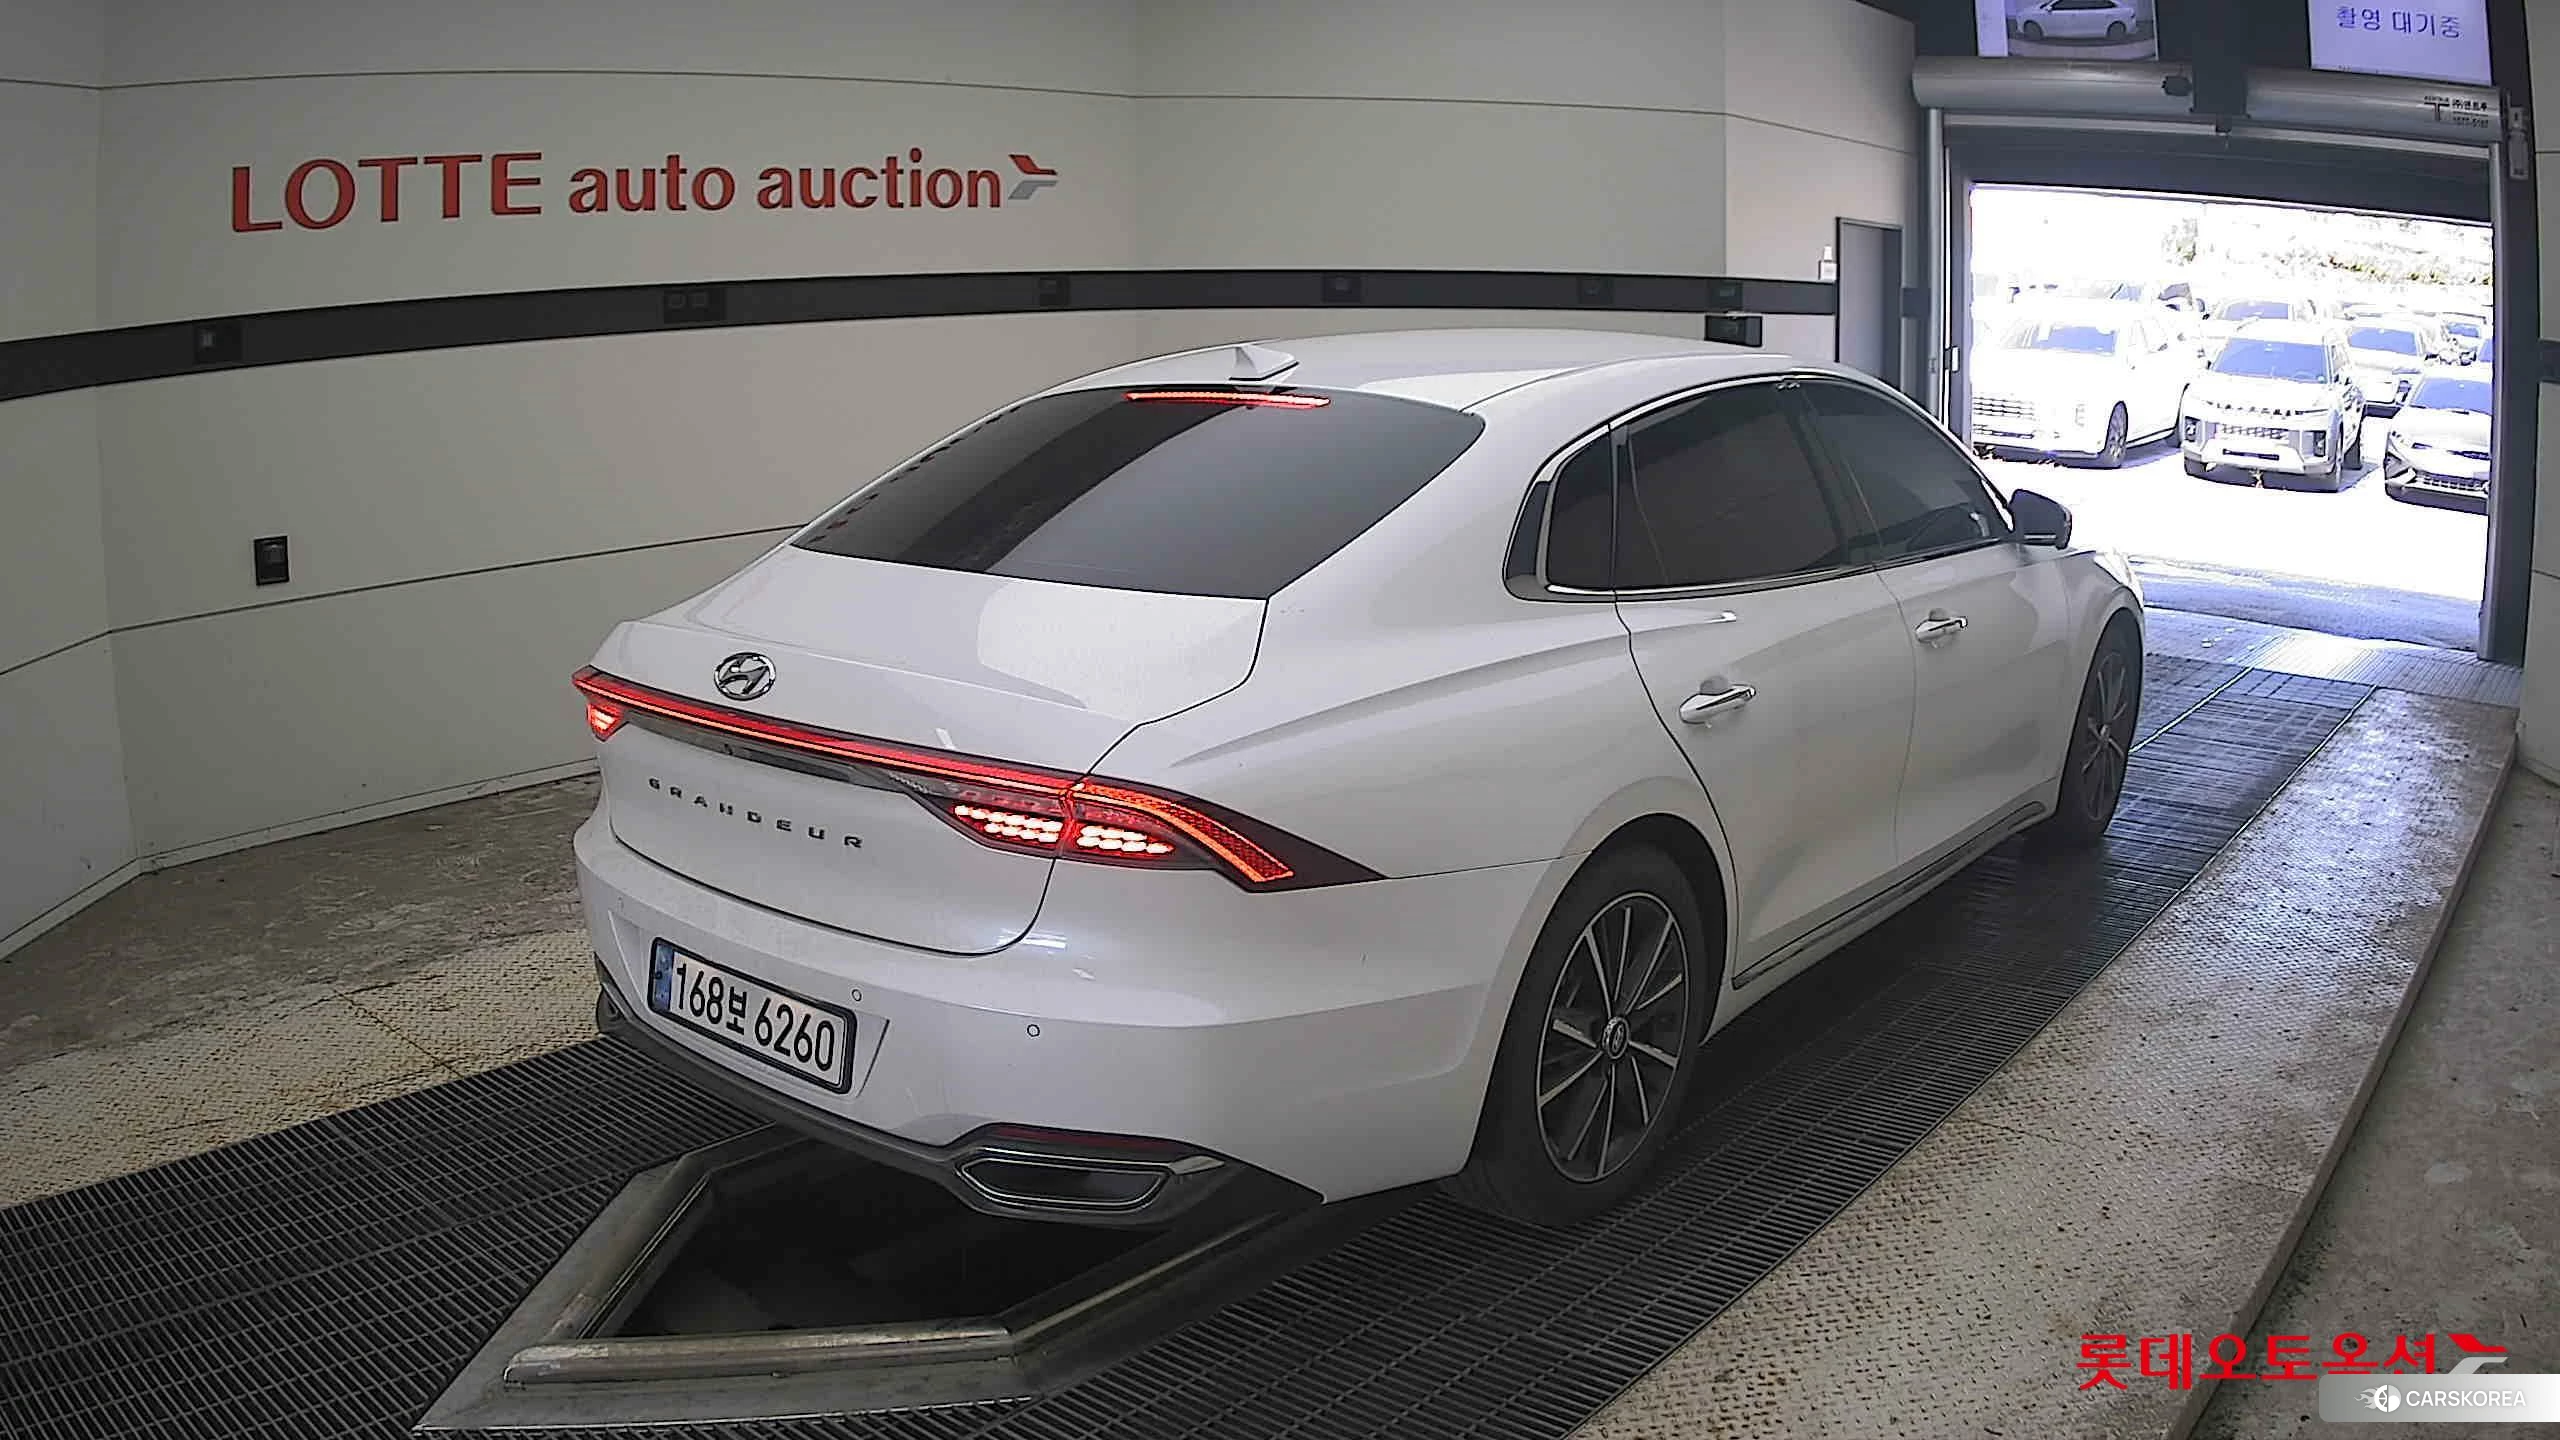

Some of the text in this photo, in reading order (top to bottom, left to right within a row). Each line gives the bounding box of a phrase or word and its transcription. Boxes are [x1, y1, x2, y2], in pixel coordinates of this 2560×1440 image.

[2337, 6, 2460, 39] 촬영 대기중
[232, 147, 1002, 232] LOTTE auto auction
[648, 777, 863, 849] GRANDEUR
[676, 963, 835, 1072] 168보 6260
